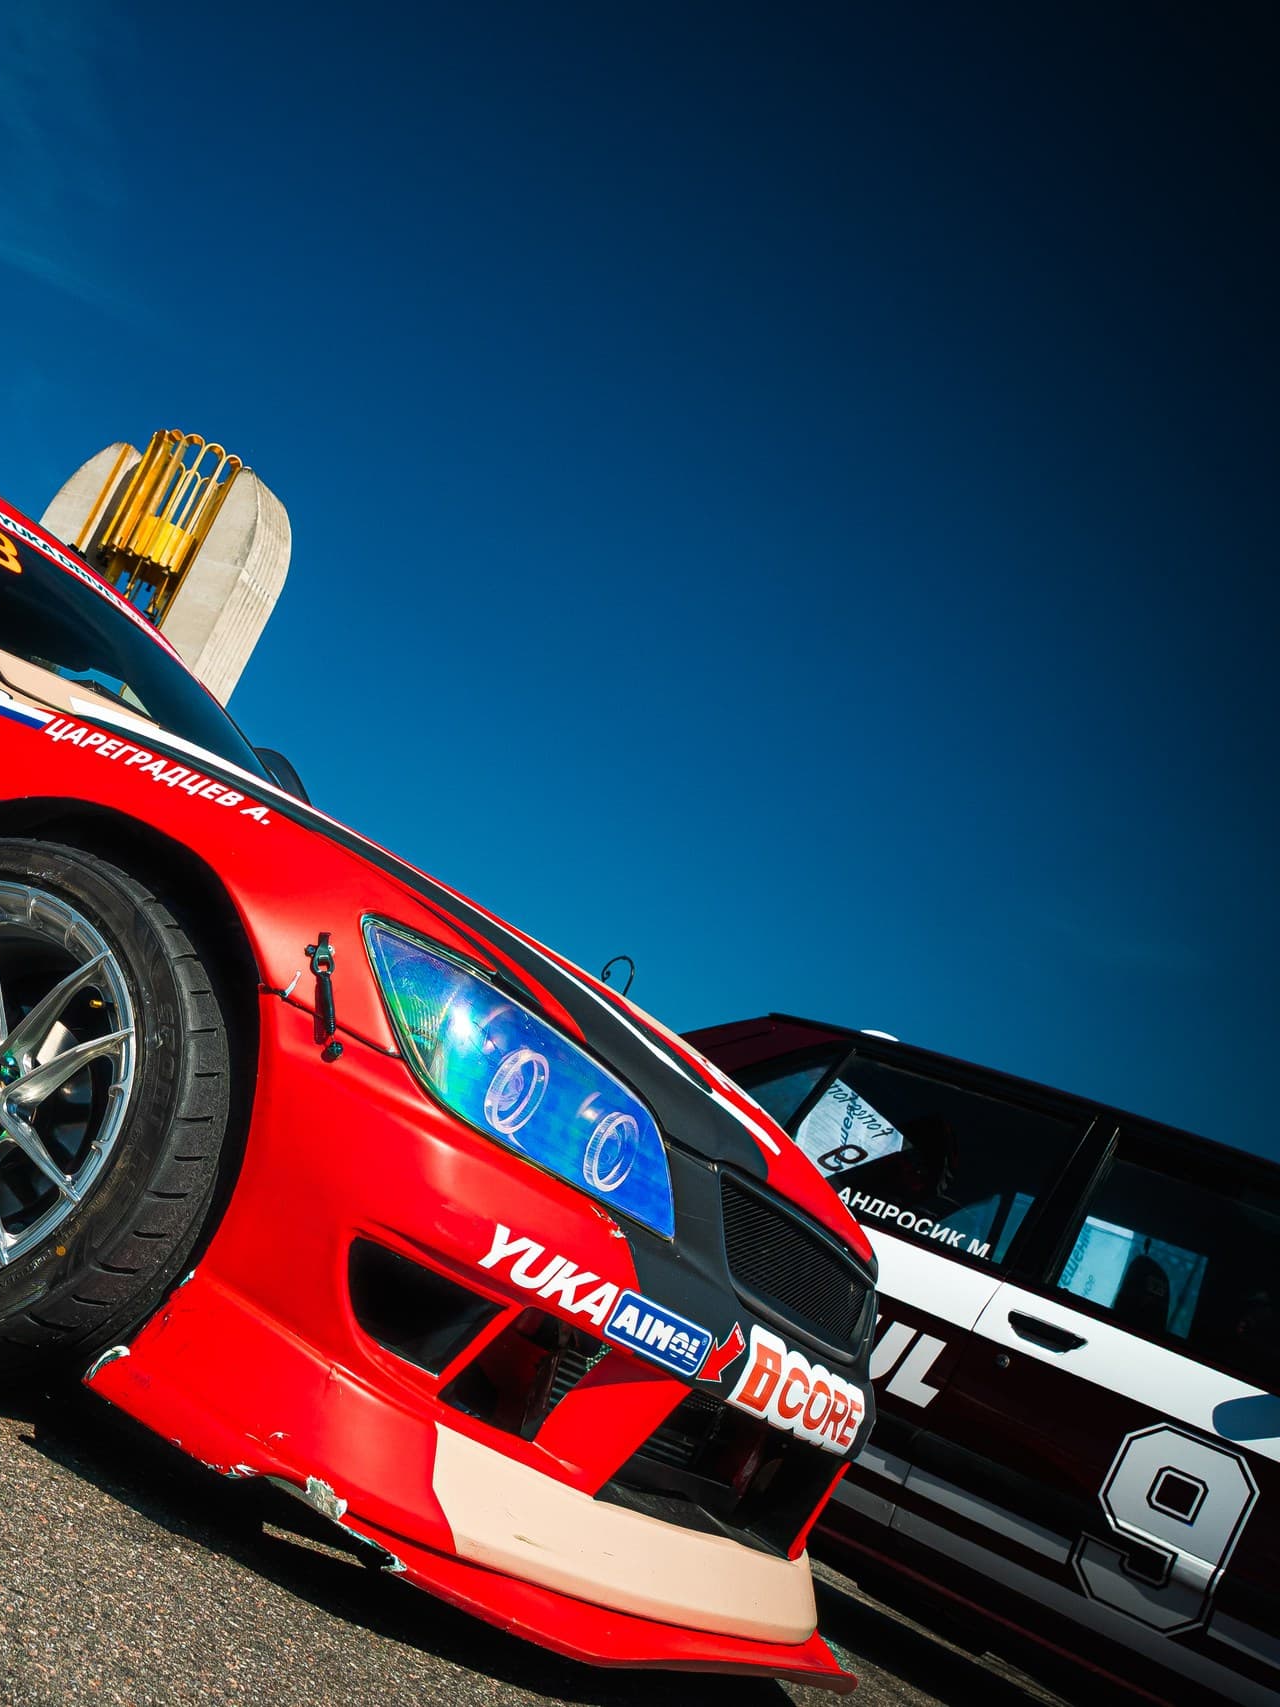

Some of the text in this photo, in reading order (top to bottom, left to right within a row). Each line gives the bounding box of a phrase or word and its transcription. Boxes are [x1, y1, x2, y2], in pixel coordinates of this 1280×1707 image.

[44, 718, 245, 807] ЦАРЕГРАДЦЕВ
[838, 1186, 967, 1249] АНДРОСИК
[477, 1223, 619, 1326] YUKA
[611, 1304, 701, 1365] AIMOL
[1072, 1422, 1261, 1638] 9
